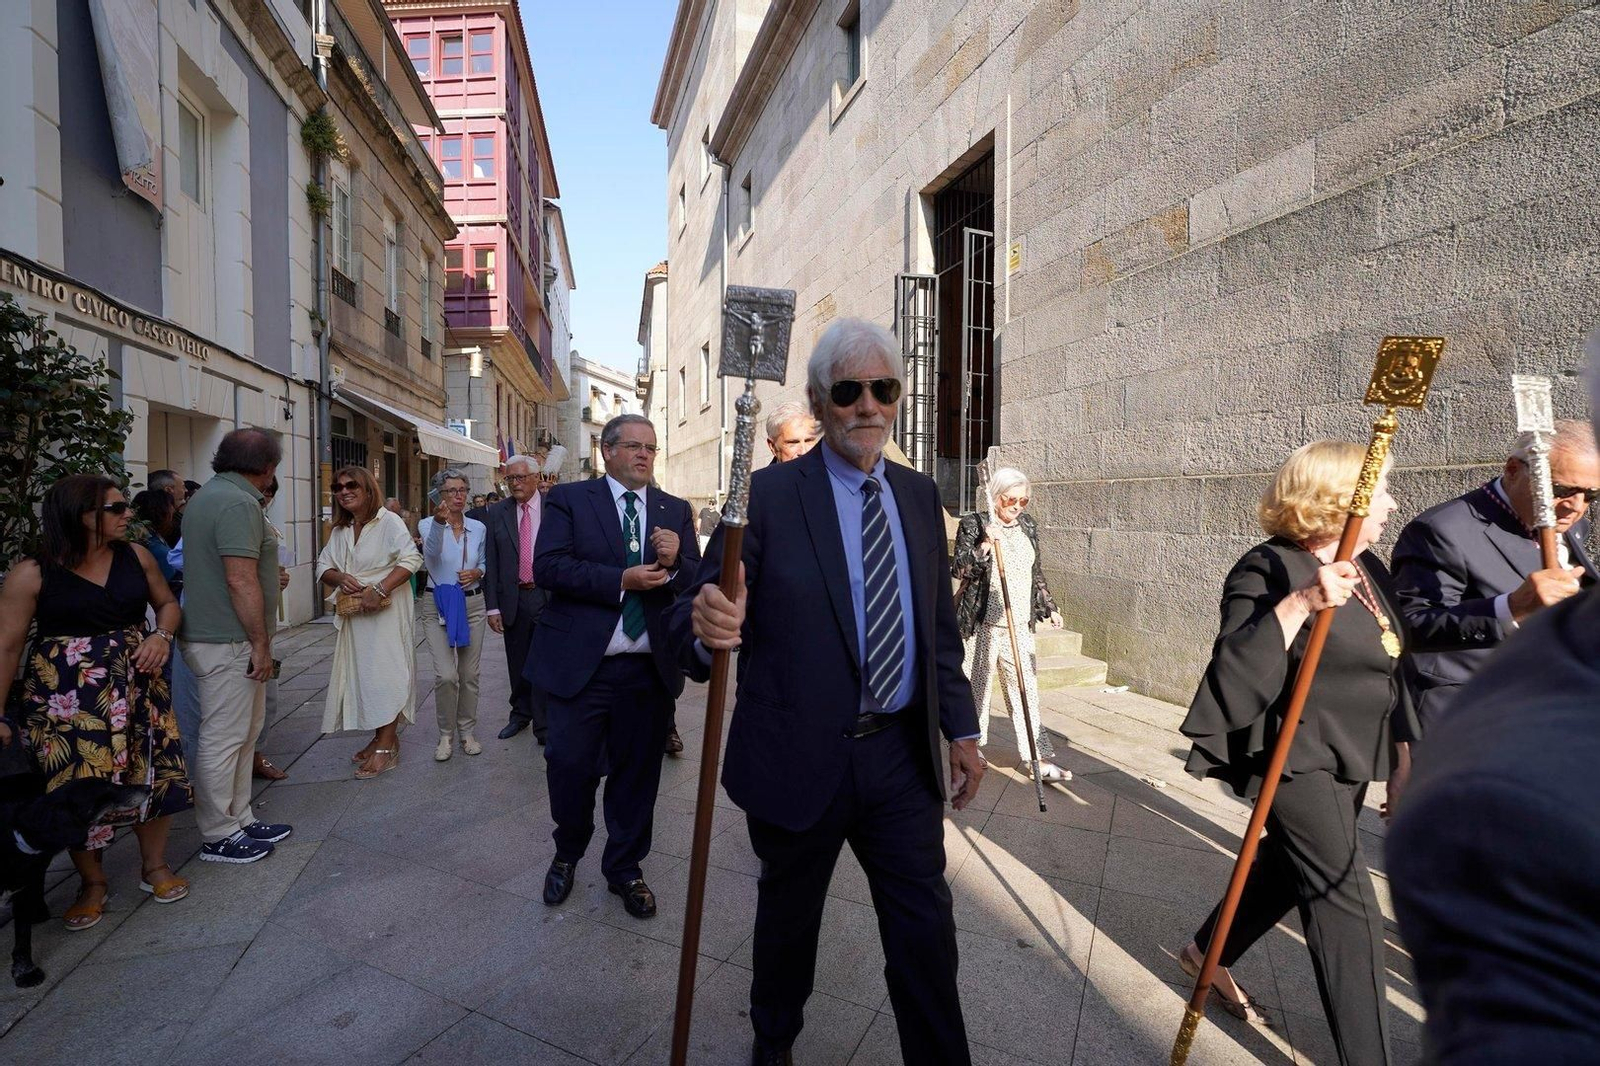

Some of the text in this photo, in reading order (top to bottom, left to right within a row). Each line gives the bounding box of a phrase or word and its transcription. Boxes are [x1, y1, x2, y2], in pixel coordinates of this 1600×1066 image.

[1, 259, 210, 360] ENTRO CIVICO CASCO VELLO
